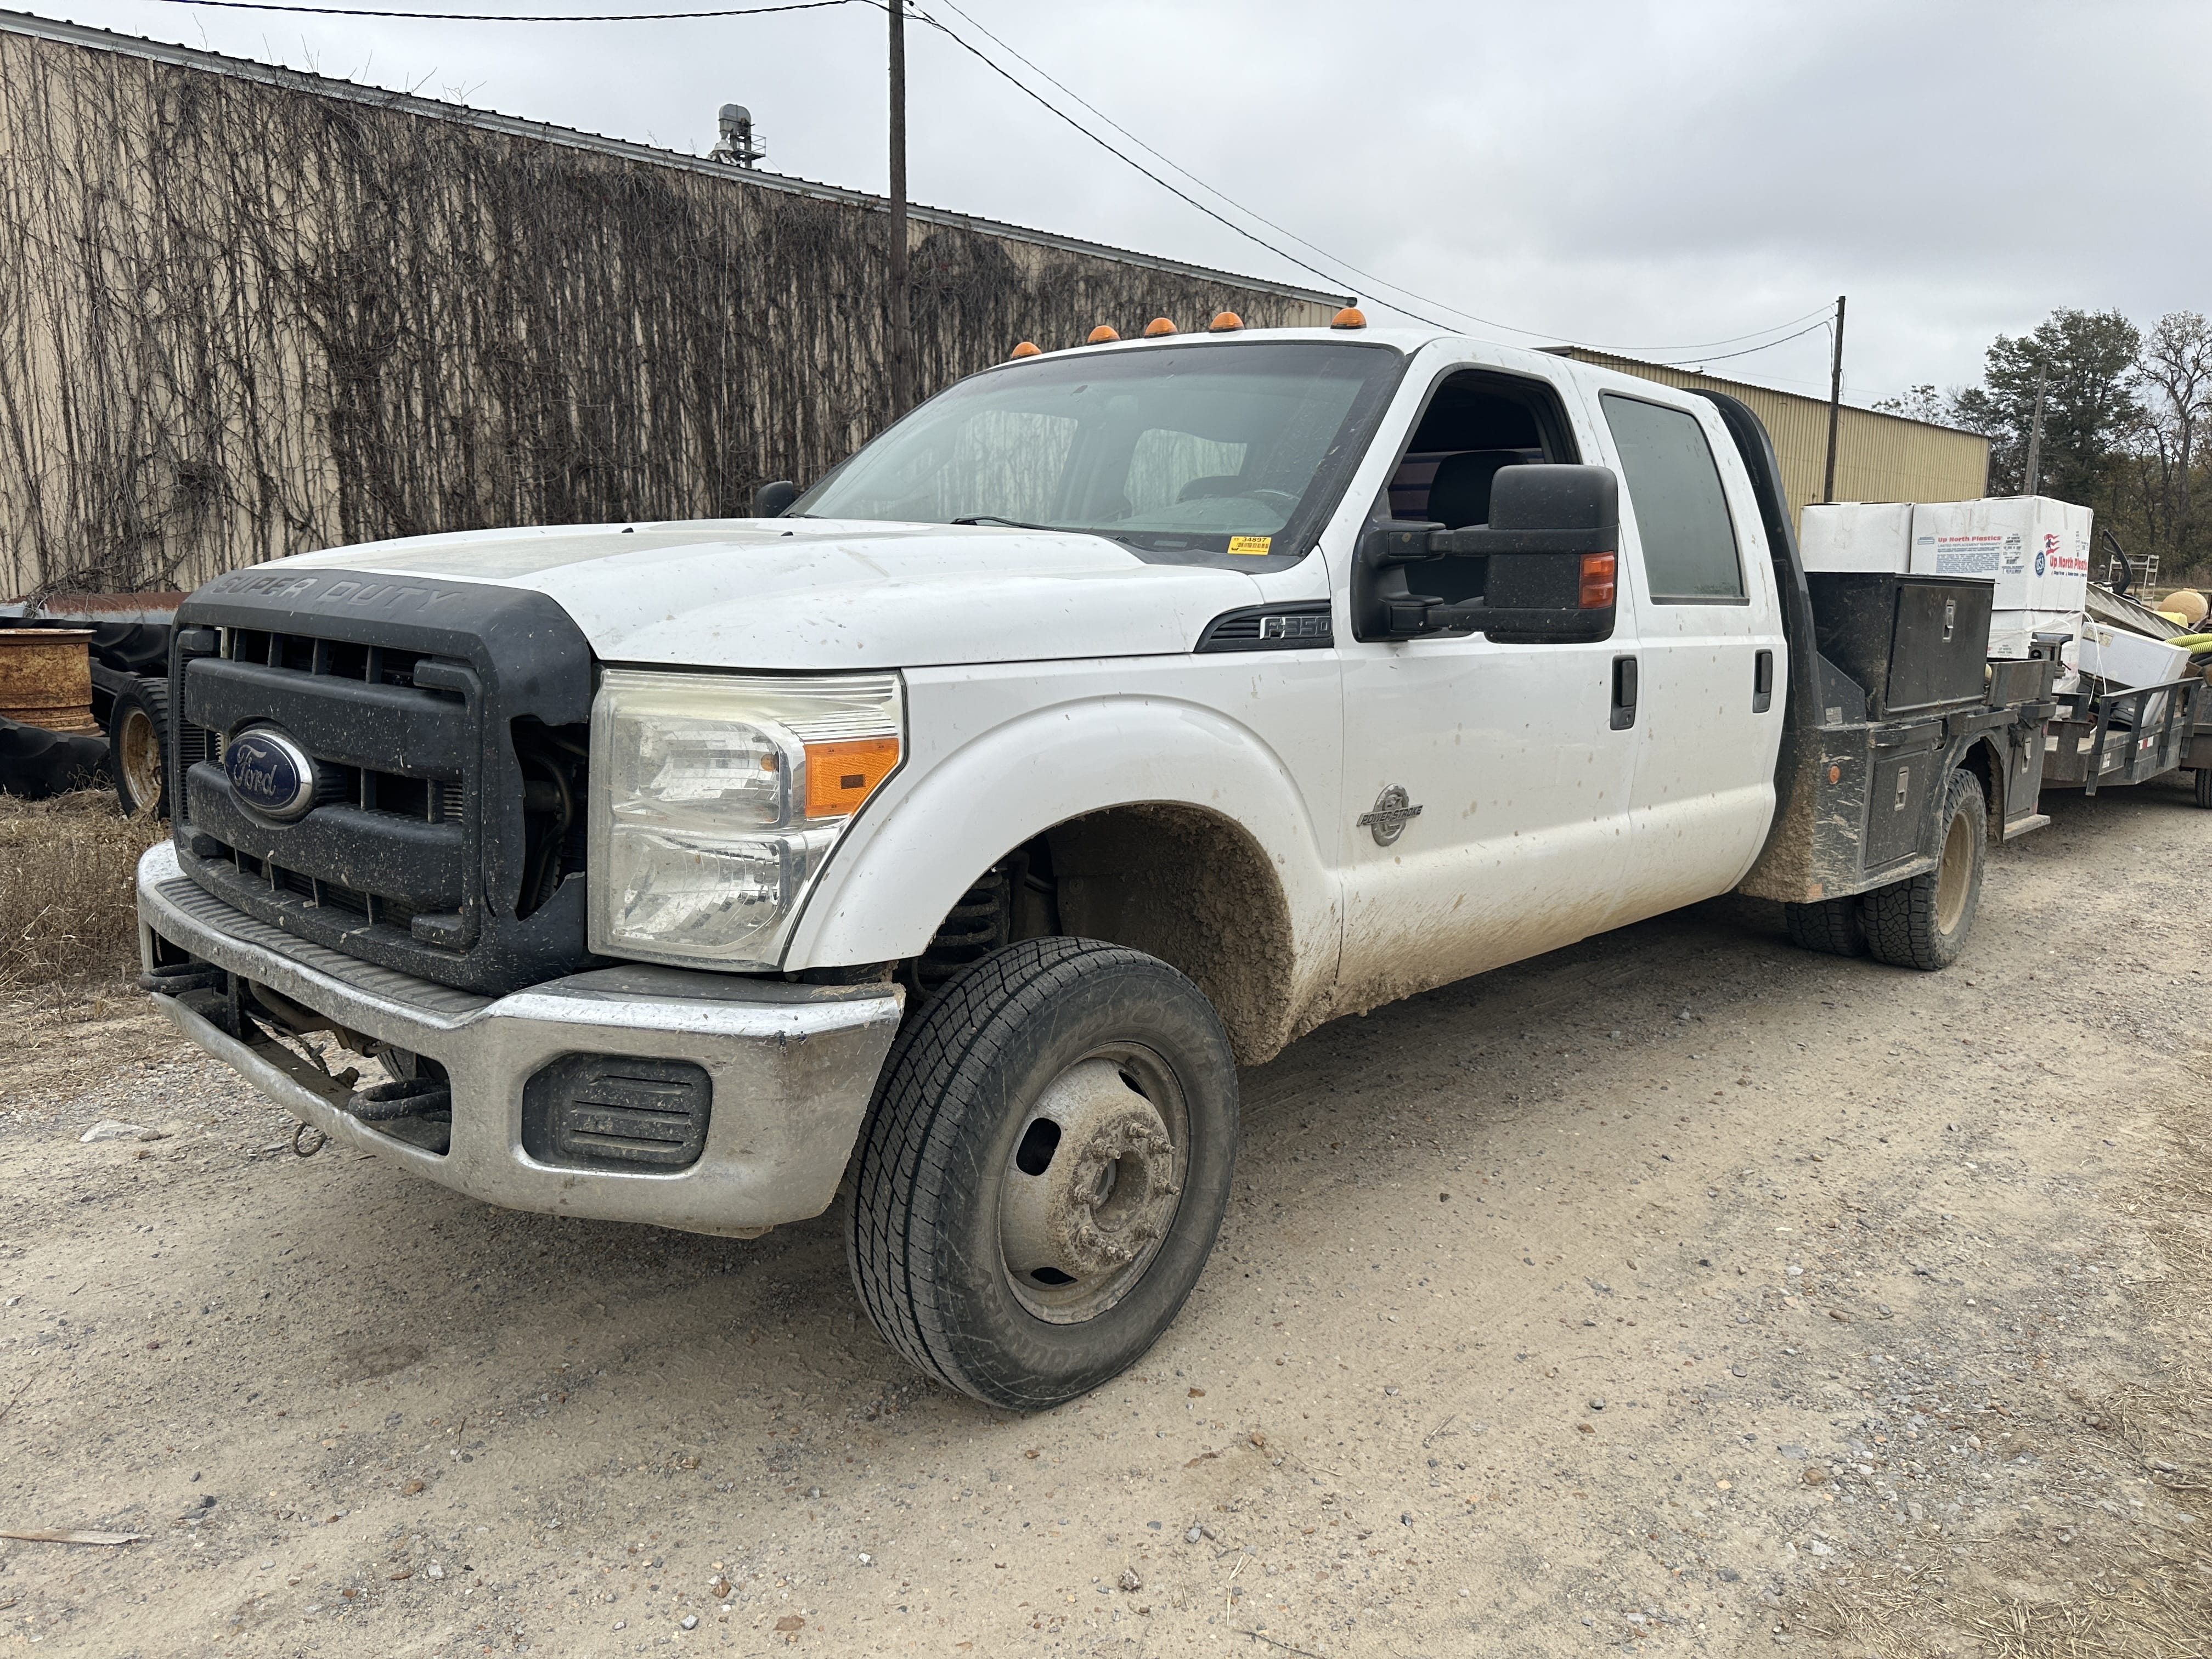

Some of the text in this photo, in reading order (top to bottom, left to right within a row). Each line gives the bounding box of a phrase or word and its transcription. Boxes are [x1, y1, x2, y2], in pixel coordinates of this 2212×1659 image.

[2036, 557, 2044, 571] USA
[2050, 555, 2057, 569] Up
[2058, 556, 2073, 569] North
[211, 575, 463, 612] SUPER DUTY
[233, 744, 278, 796] Ford
[1361, 805, 1423, 824] POWER STROKE
